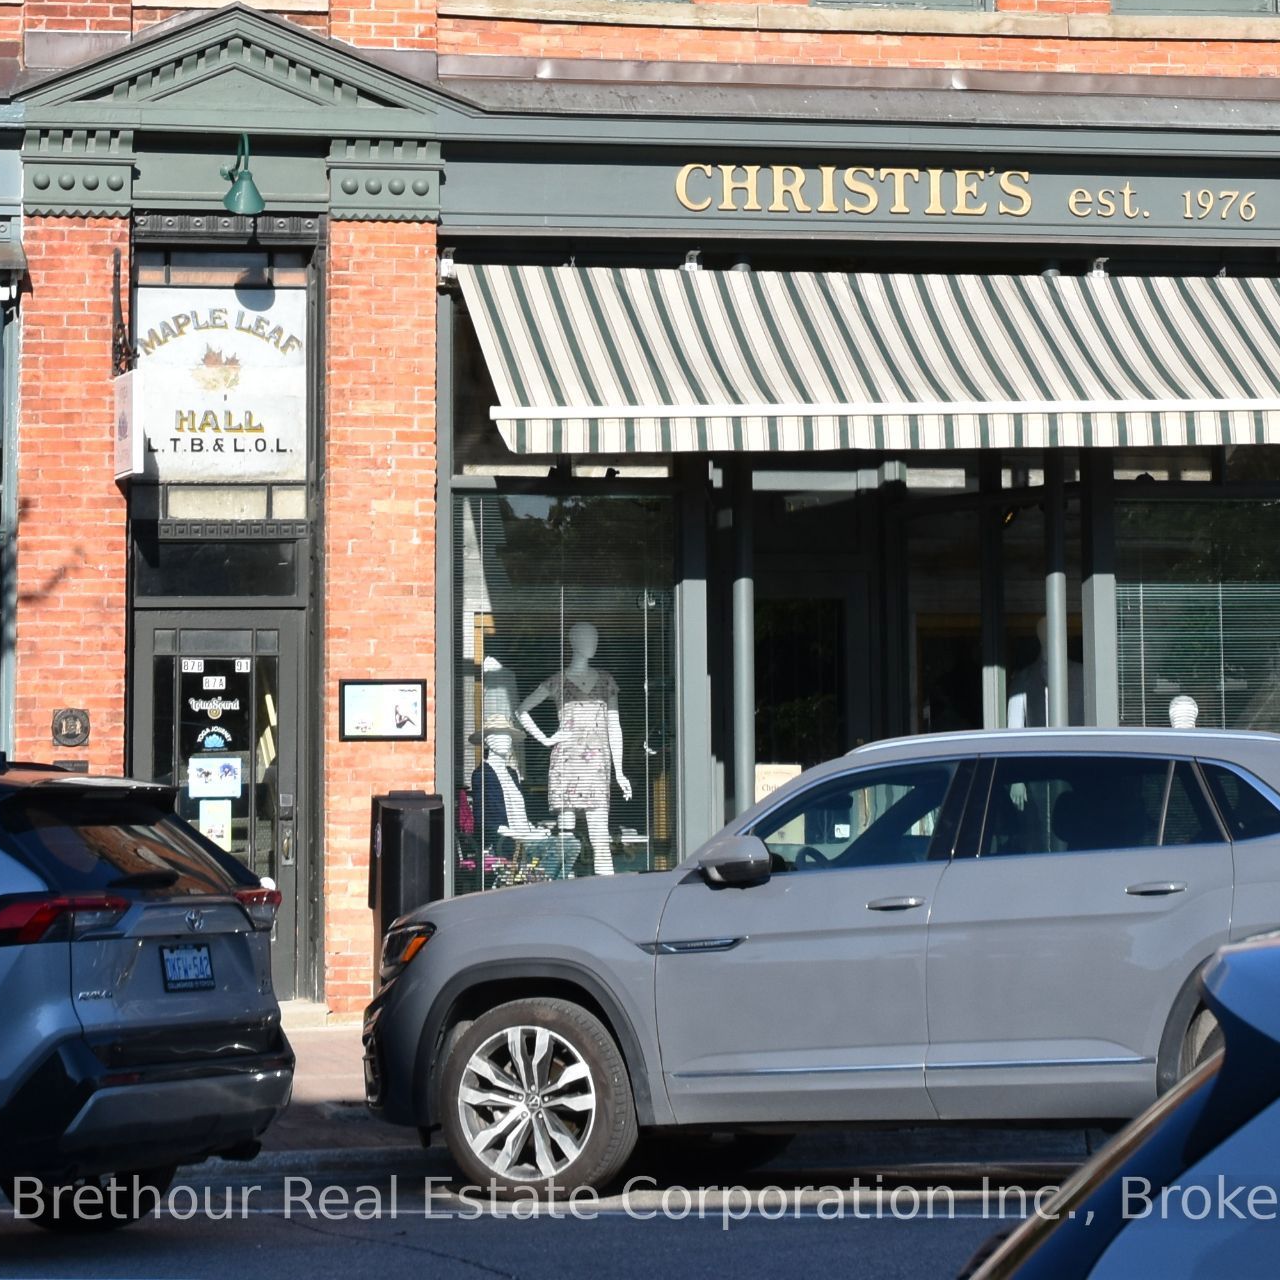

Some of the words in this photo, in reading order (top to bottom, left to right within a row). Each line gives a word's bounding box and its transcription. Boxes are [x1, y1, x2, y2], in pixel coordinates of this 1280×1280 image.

[675, 163, 1033, 216] CHRISTIE'S
[1068, 181, 1150, 219] est.
[1182, 189, 1257, 221] 1976
[137, 308, 229, 356] MAPLE
[235, 310, 303, 354] LEAF
[175, 410, 264, 433] HALL
[233, 438, 293, 453] L.O.L.
